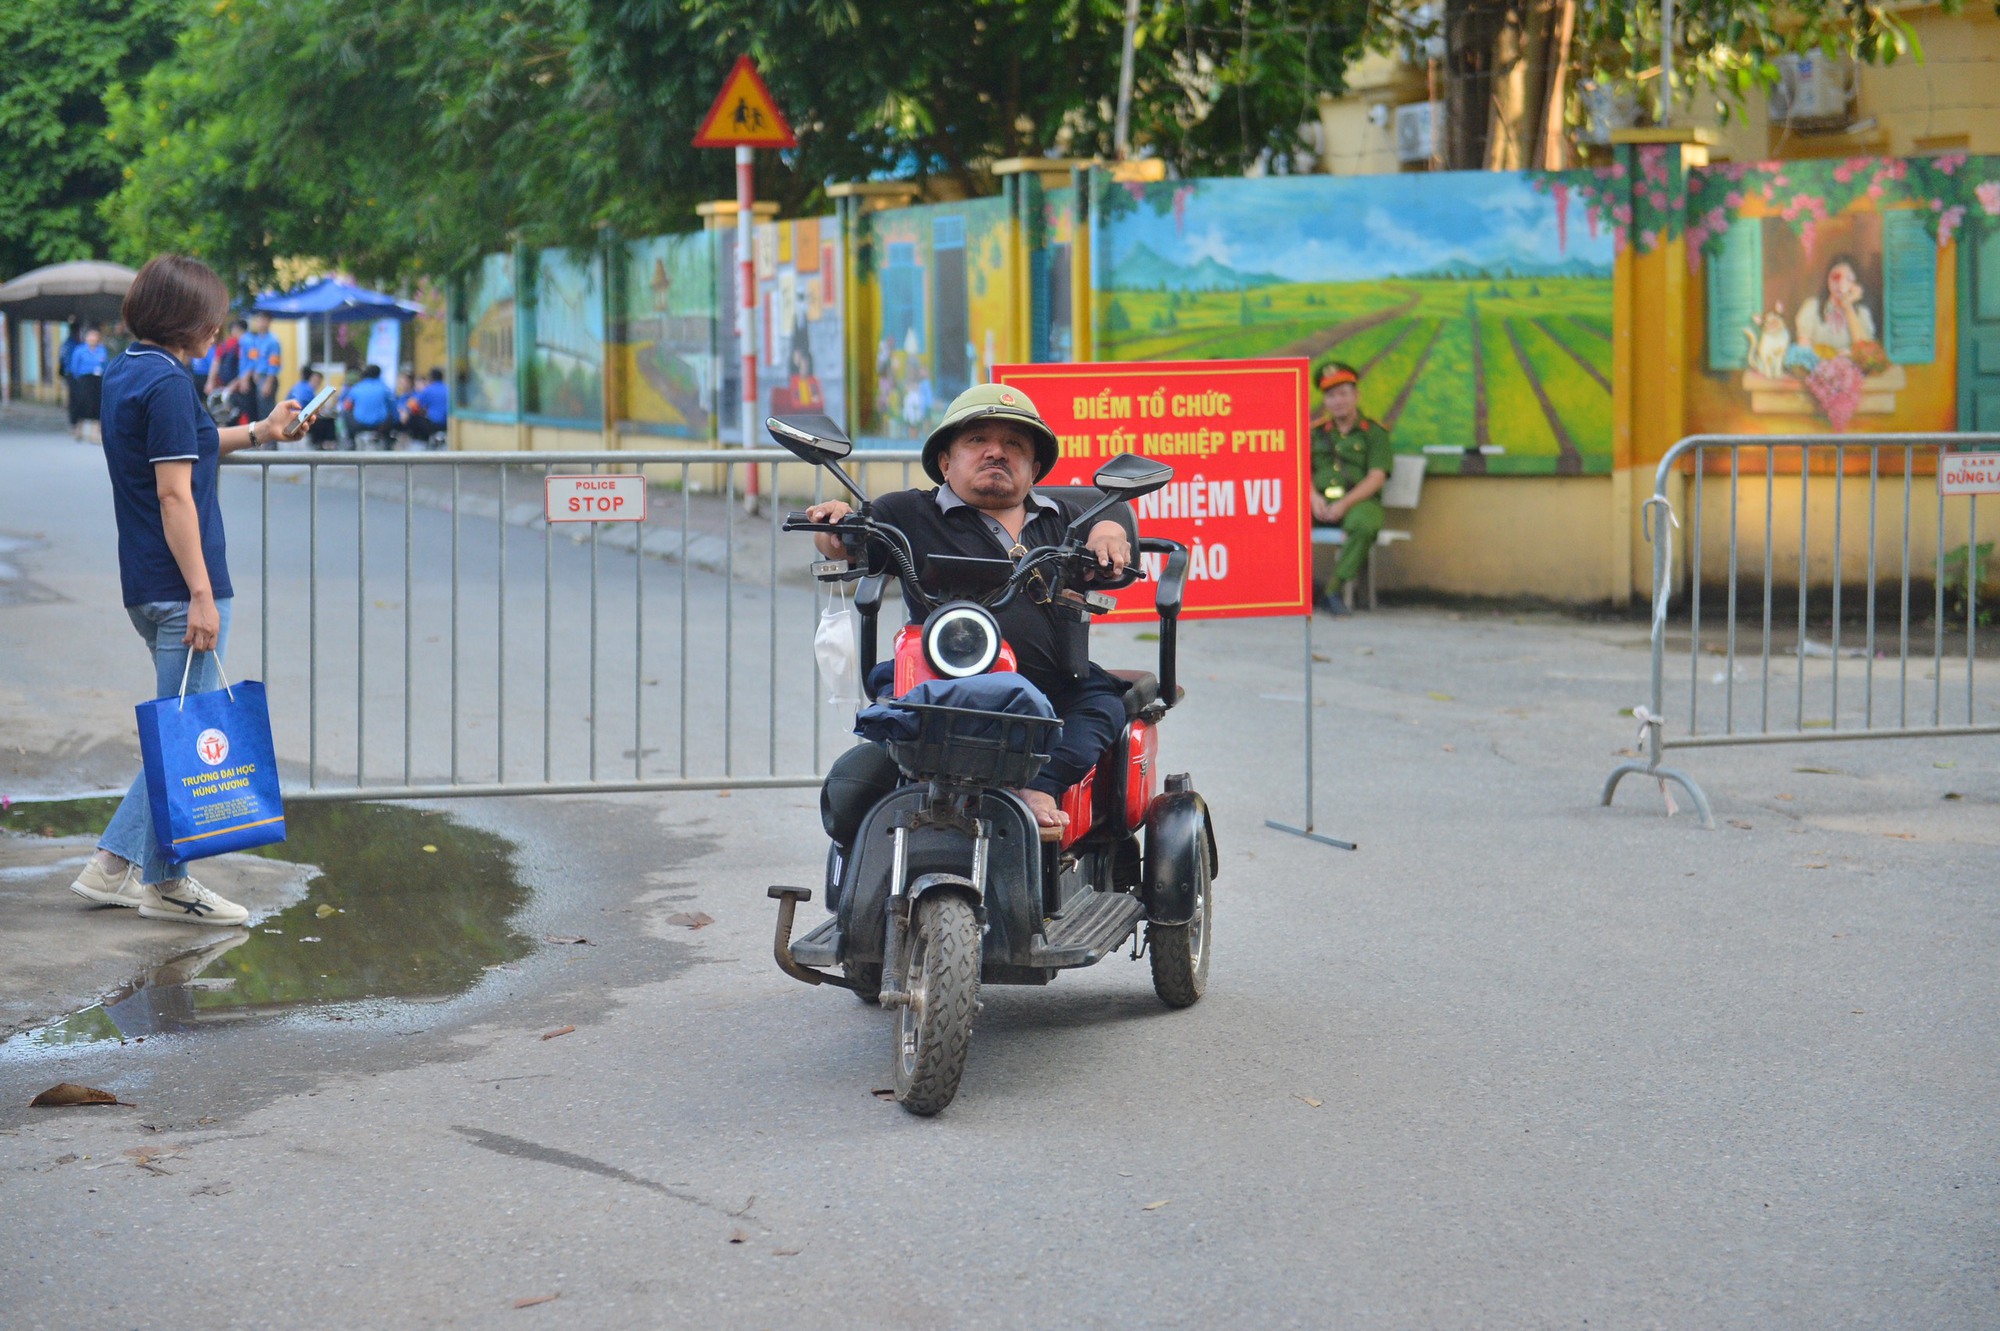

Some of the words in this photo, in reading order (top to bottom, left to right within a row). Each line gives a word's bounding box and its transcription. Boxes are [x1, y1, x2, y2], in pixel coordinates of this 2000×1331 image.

[1073, 388, 1131, 420] ĐIỂM
[1137, 386, 1166, 418] TỔ
[1171, 389, 1232, 418] CHỨC
[1058, 434, 1090, 458] THI
[1097, 426, 1136, 457] TỐT
[1143, 427, 1225, 459] NGHIỆP
[1231, 429, 1285, 453] PTTH
[576, 481, 616, 490] POLICE
[569, 496, 624, 512] STOP
[1138, 474, 1235, 526] NHIỆM
[1243, 478, 1281, 523] VỤ
[1187, 537, 1228, 581] ÀO
[236, 763, 256, 776] HỌC
[192, 784, 218, 798] HÙNG
